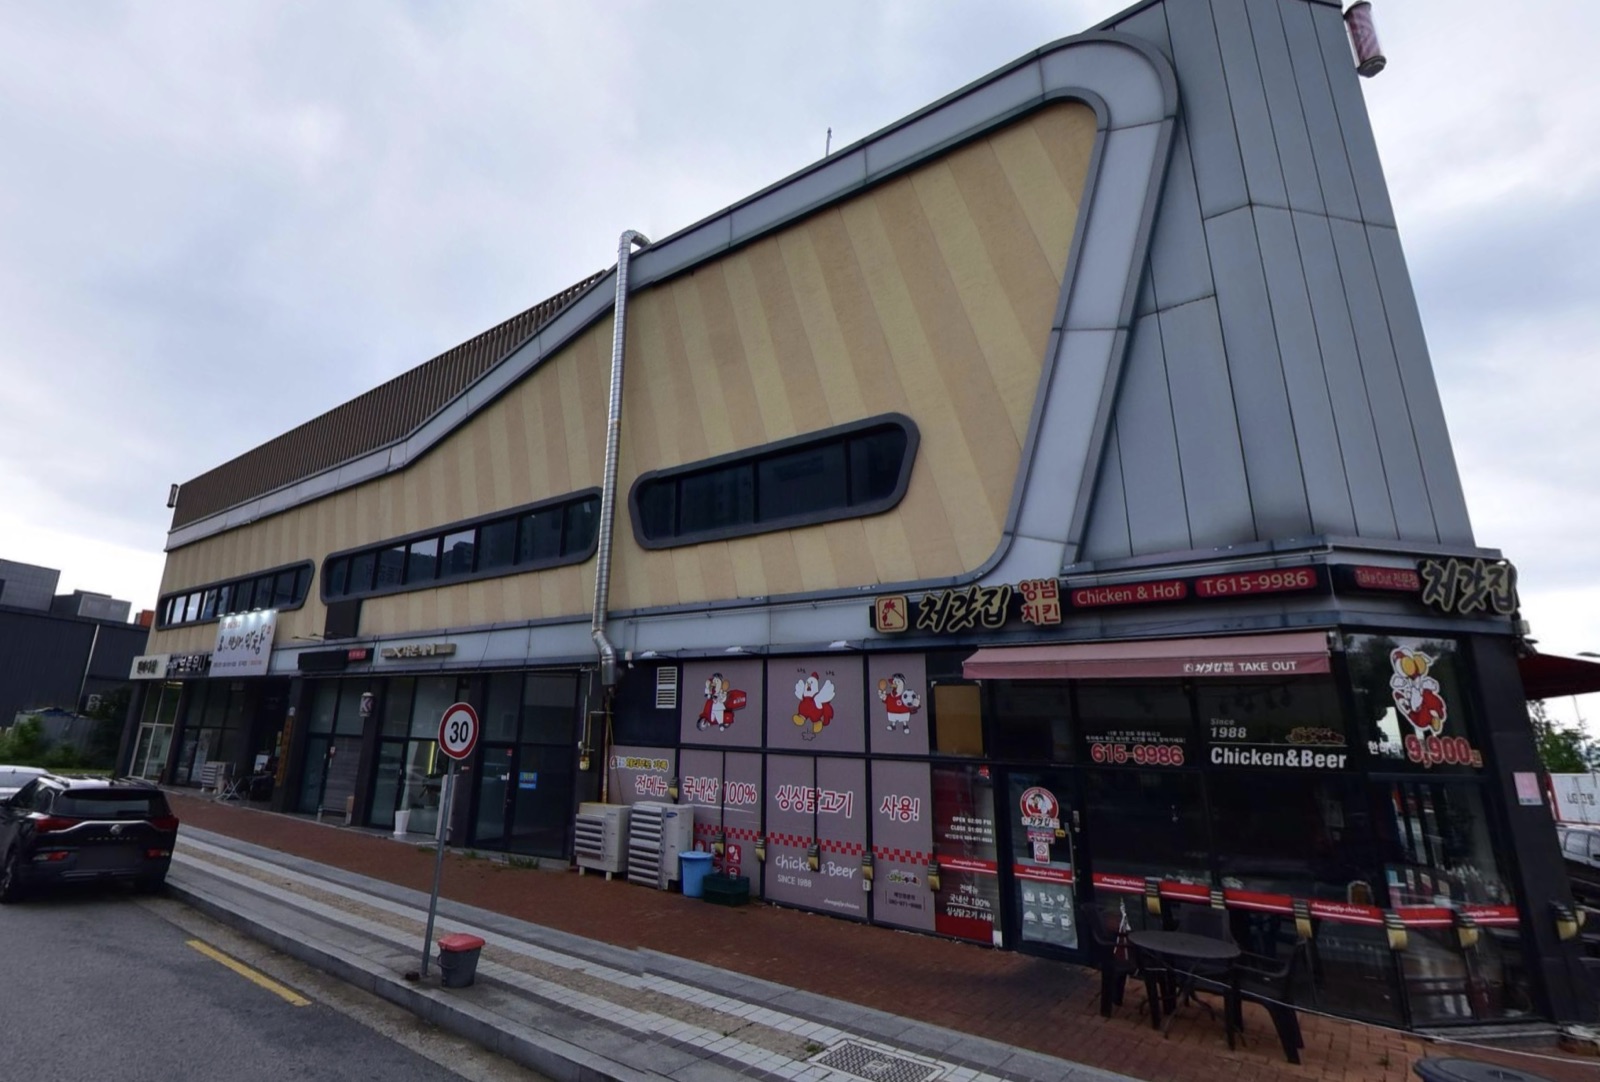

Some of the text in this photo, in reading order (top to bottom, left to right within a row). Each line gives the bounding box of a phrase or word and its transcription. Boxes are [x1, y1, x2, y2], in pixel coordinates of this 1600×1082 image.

[1018, 577, 1059, 602] 양념
[1077, 582, 1181, 605] Chicken & Hof
[1202, 570, 1309, 596] T.615-9986
[1422, 558, 1517, 614] 처갓집
[916, 583, 1012, 633] 처갓집
[1020, 601, 1061, 626] 치킨
[1239, 662, 1269, 672] TAKE
[1271, 661, 1297, 671] OUT
[449, 721, 469, 744] 30
[1210, 718, 1235, 726] Since
[1210, 727, 1247, 738] 1988
[1091, 743, 1185, 766] 615-9986
[1210, 747, 1348, 769] Chicken&Beer
[635, 774, 921, 823] 전메뉴 국내산 100% 싱싱닭고기 사용!
[777, 874, 812, 888] SINCE 1988
[827, 861, 857, 879] Beer
[971, 896, 990, 908] 100%
